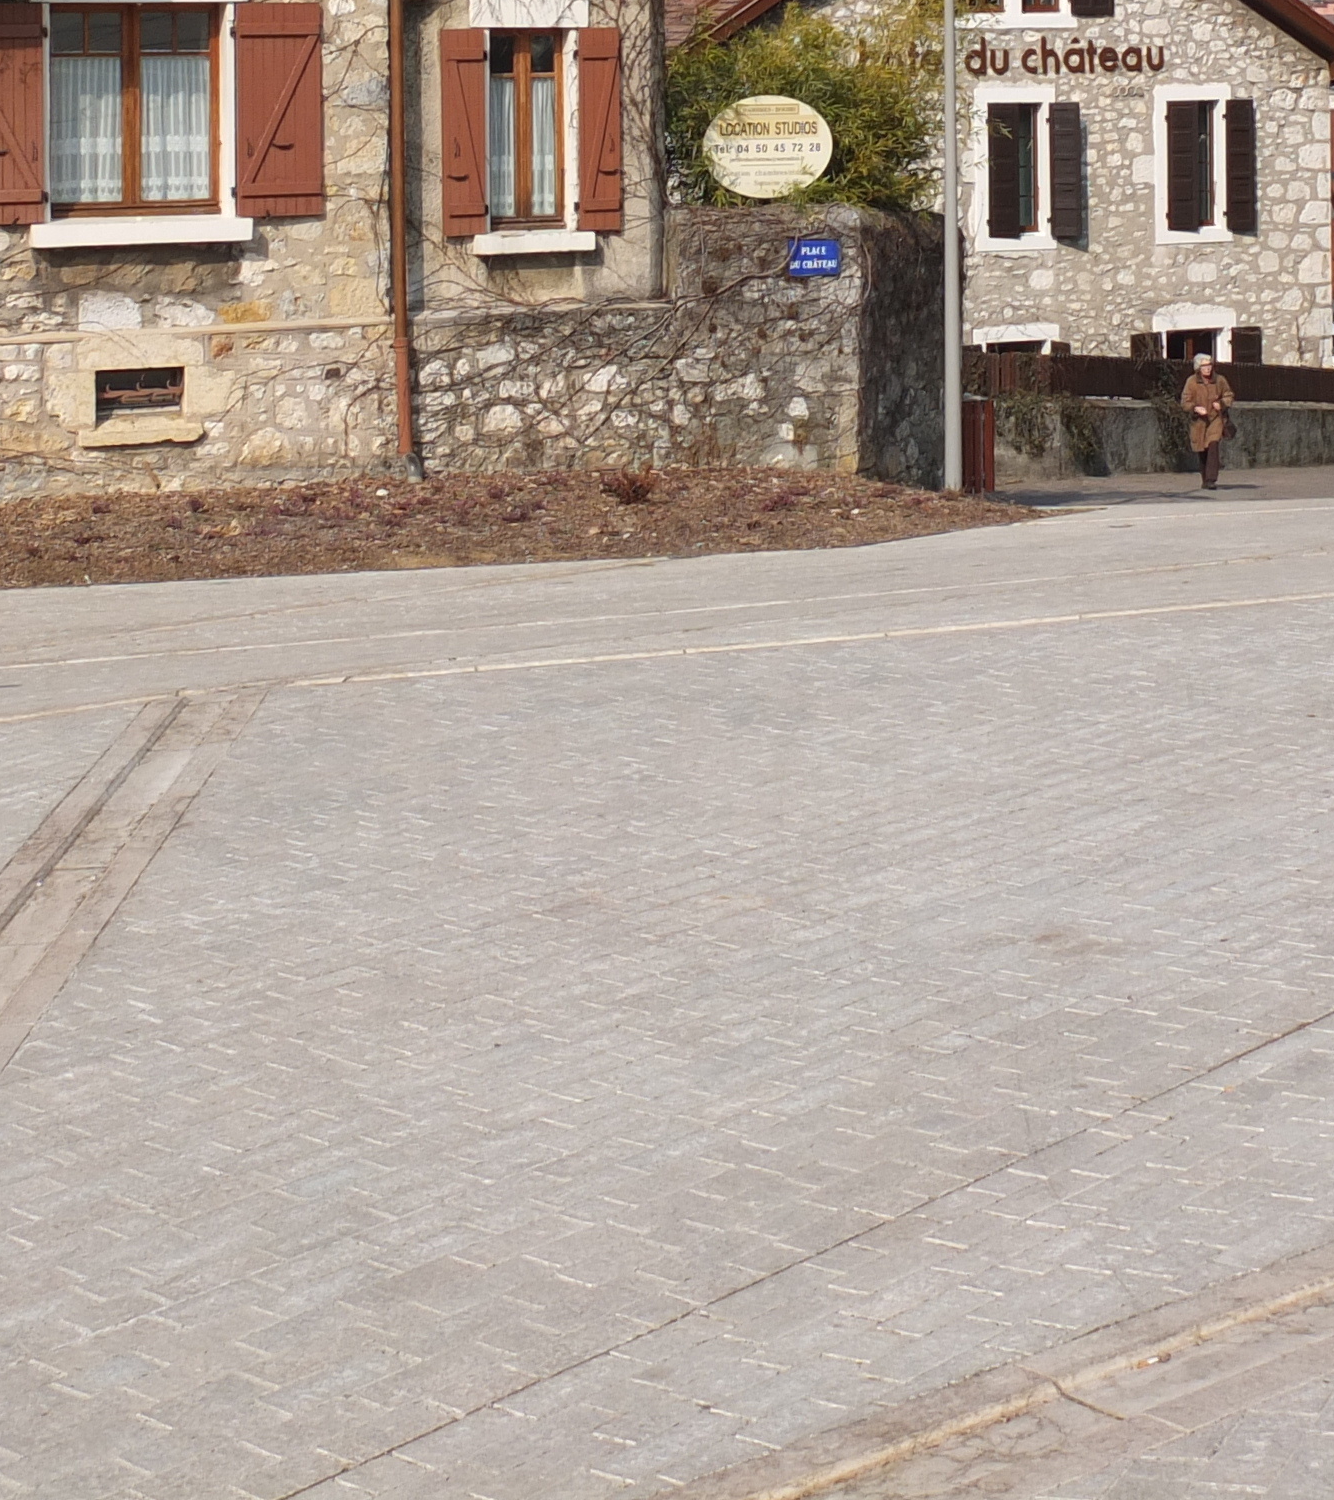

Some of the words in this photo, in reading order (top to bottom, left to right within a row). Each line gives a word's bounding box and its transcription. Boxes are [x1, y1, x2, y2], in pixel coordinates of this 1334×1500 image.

[966, 36, 1010, 76] du
[1020, 35, 1165, 76] château
[719, 121, 770, 136] LOCATION
[775, 120, 818, 135] STUDIOS
[737, 144, 750, 154] 04
[755, 143, 768, 154] 50
[773, 143, 786, 153] 45
[791, 142, 804, 153] 72
[809, 142, 821, 153] 28
[801, 246, 827, 256] PLACE
[802, 258, 838, 269] CHÂTEAU
